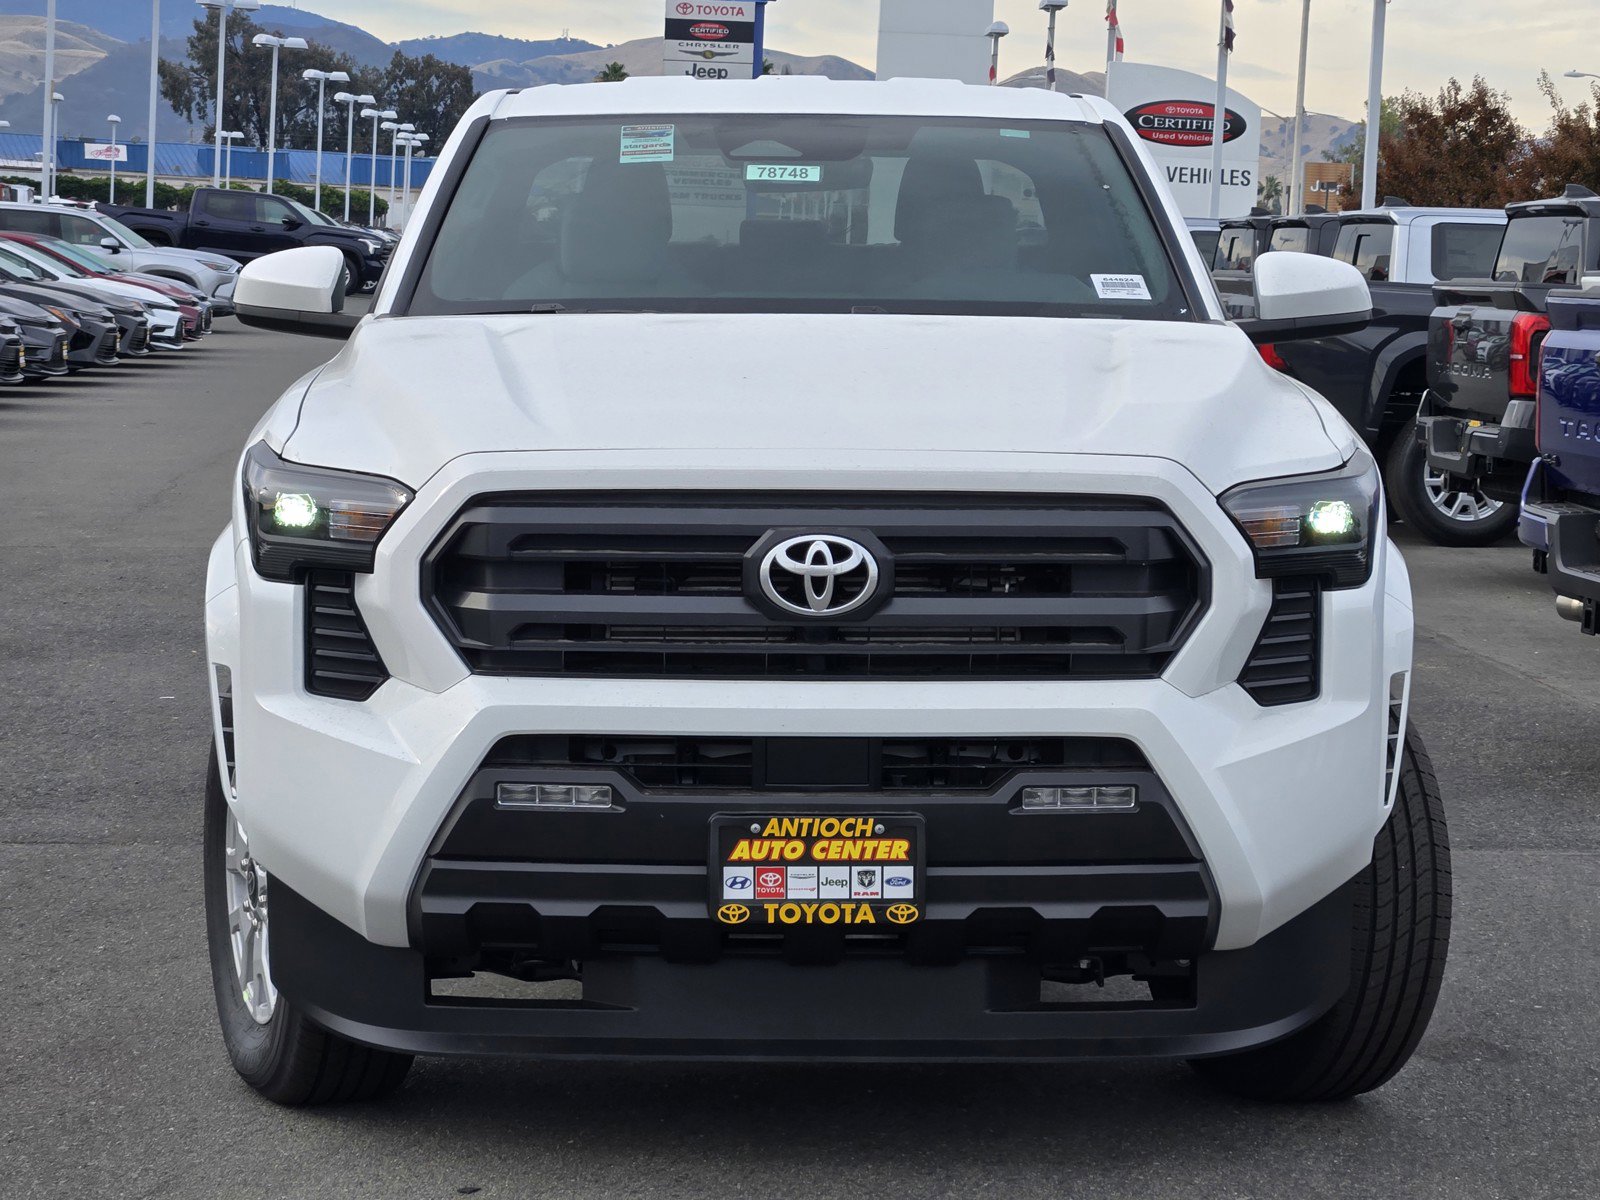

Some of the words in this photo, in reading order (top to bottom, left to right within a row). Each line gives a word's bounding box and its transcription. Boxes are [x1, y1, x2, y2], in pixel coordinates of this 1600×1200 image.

[696, 5, 745, 16] TOYOTA
[685, 63, 728, 79] Jeep
[1176, 107, 1204, 115] TOYOTA
[1152, 132, 1176, 140] Used
[665, 169, 742, 179] COMMERCIA
[757, 167, 809, 179] 78748
[1166, 166, 1251, 187] VEHILES
[1435, 362, 1492, 379] TACOMA
[762, 818, 875, 837] ANTIOCH
[727, 838, 805, 862] AUTO
[811, 838, 910, 862] CENTER
[821, 877, 848, 888] Jeep
[764, 903, 876, 924] TOYOTA
